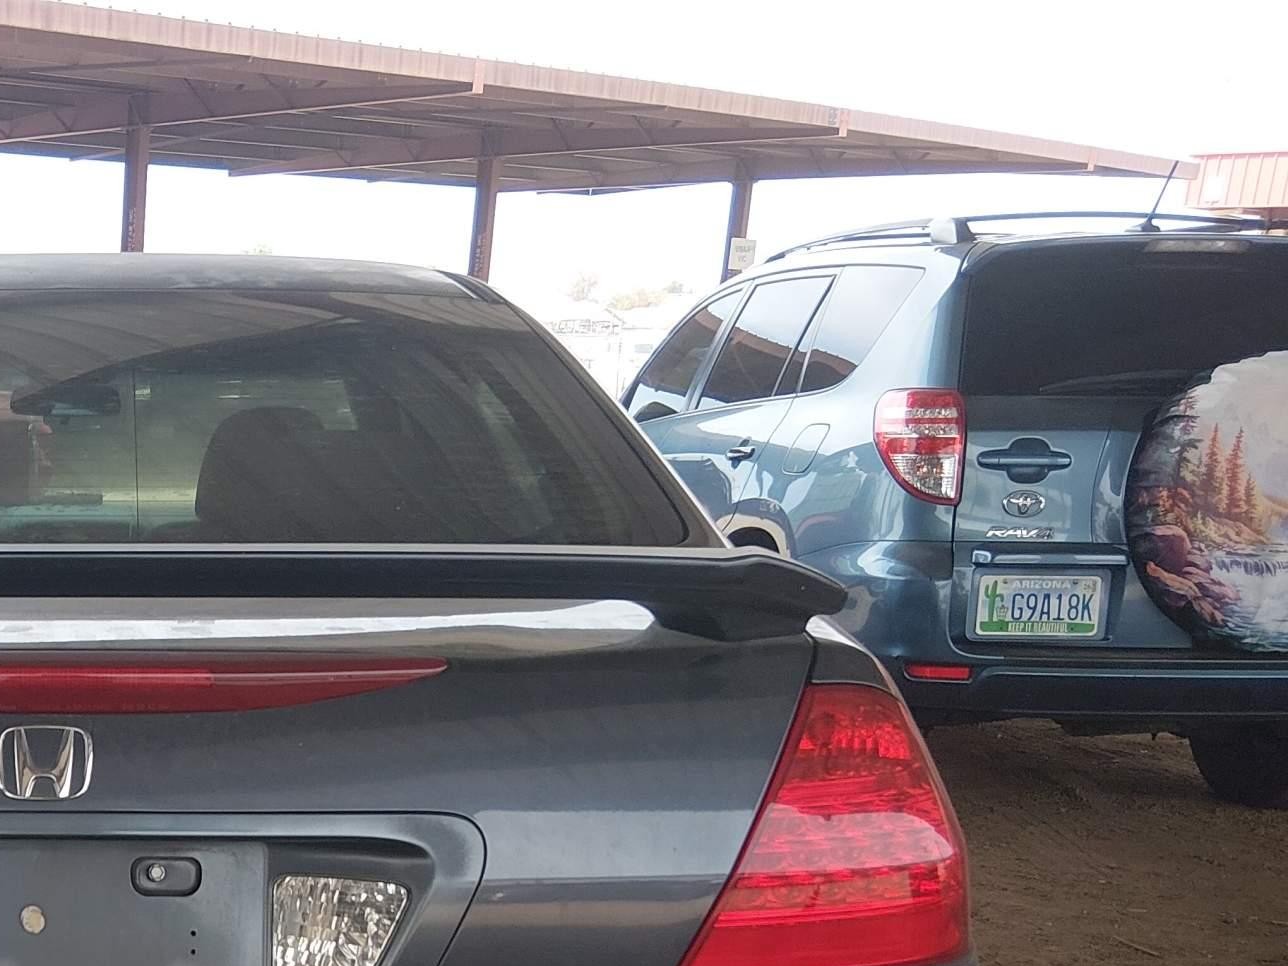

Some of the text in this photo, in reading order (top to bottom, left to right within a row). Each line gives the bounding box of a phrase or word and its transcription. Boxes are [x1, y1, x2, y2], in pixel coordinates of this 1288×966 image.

[985, 527, 1053, 539] RAV4
[1012, 579, 1072, 590] ARIZONA
[1010, 592, 1094, 622] G9A18K
[1007, 621, 1069, 633] KEEP IT BEAUTIFUL
